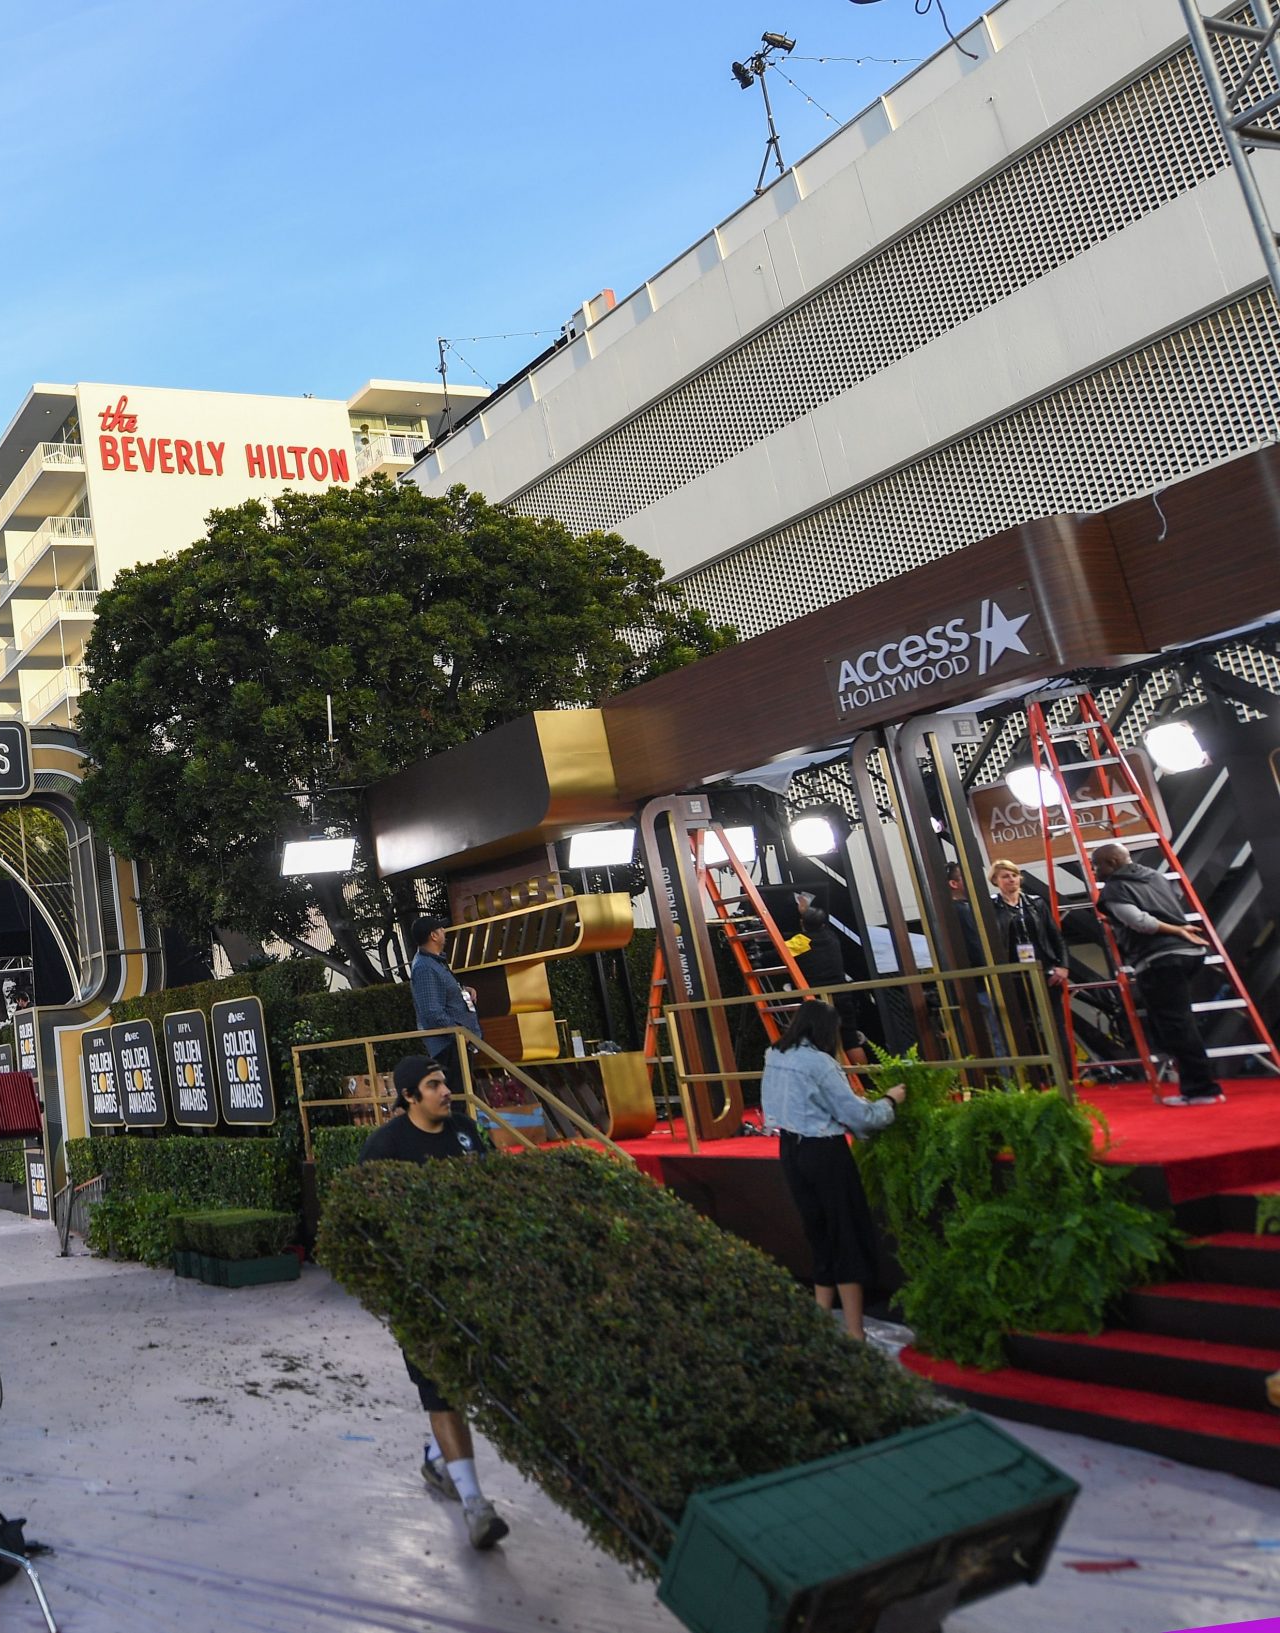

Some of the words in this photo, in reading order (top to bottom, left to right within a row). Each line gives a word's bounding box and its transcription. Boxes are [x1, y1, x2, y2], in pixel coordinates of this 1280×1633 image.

[98, 395, 138, 433] the
[98, 435, 225, 476] BEVERLY
[245, 444, 350, 482] HILTON
[839, 655, 970, 712] HOLLYWOOD
[173, 1040, 202, 1063] GOLDEN
[223, 1029, 257, 1057] GOLDEN
[89, 1051, 113, 1073] GOLDEN
[121, 1046, 150, 1070] GOLDEN
[226, 1056, 260, 1082] GLOBE
[91, 1072, 115, 1093] GLOBE
[124, 1069, 154, 1092] GLOBE
[175, 1063, 206, 1087] GLOBE
[93, 1093, 118, 1114] AWARDS
[128, 1091, 157, 1114] AWARDS
[179, 1088, 208, 1111] AWARDS
[230, 1082, 264, 1108] AWARDS
